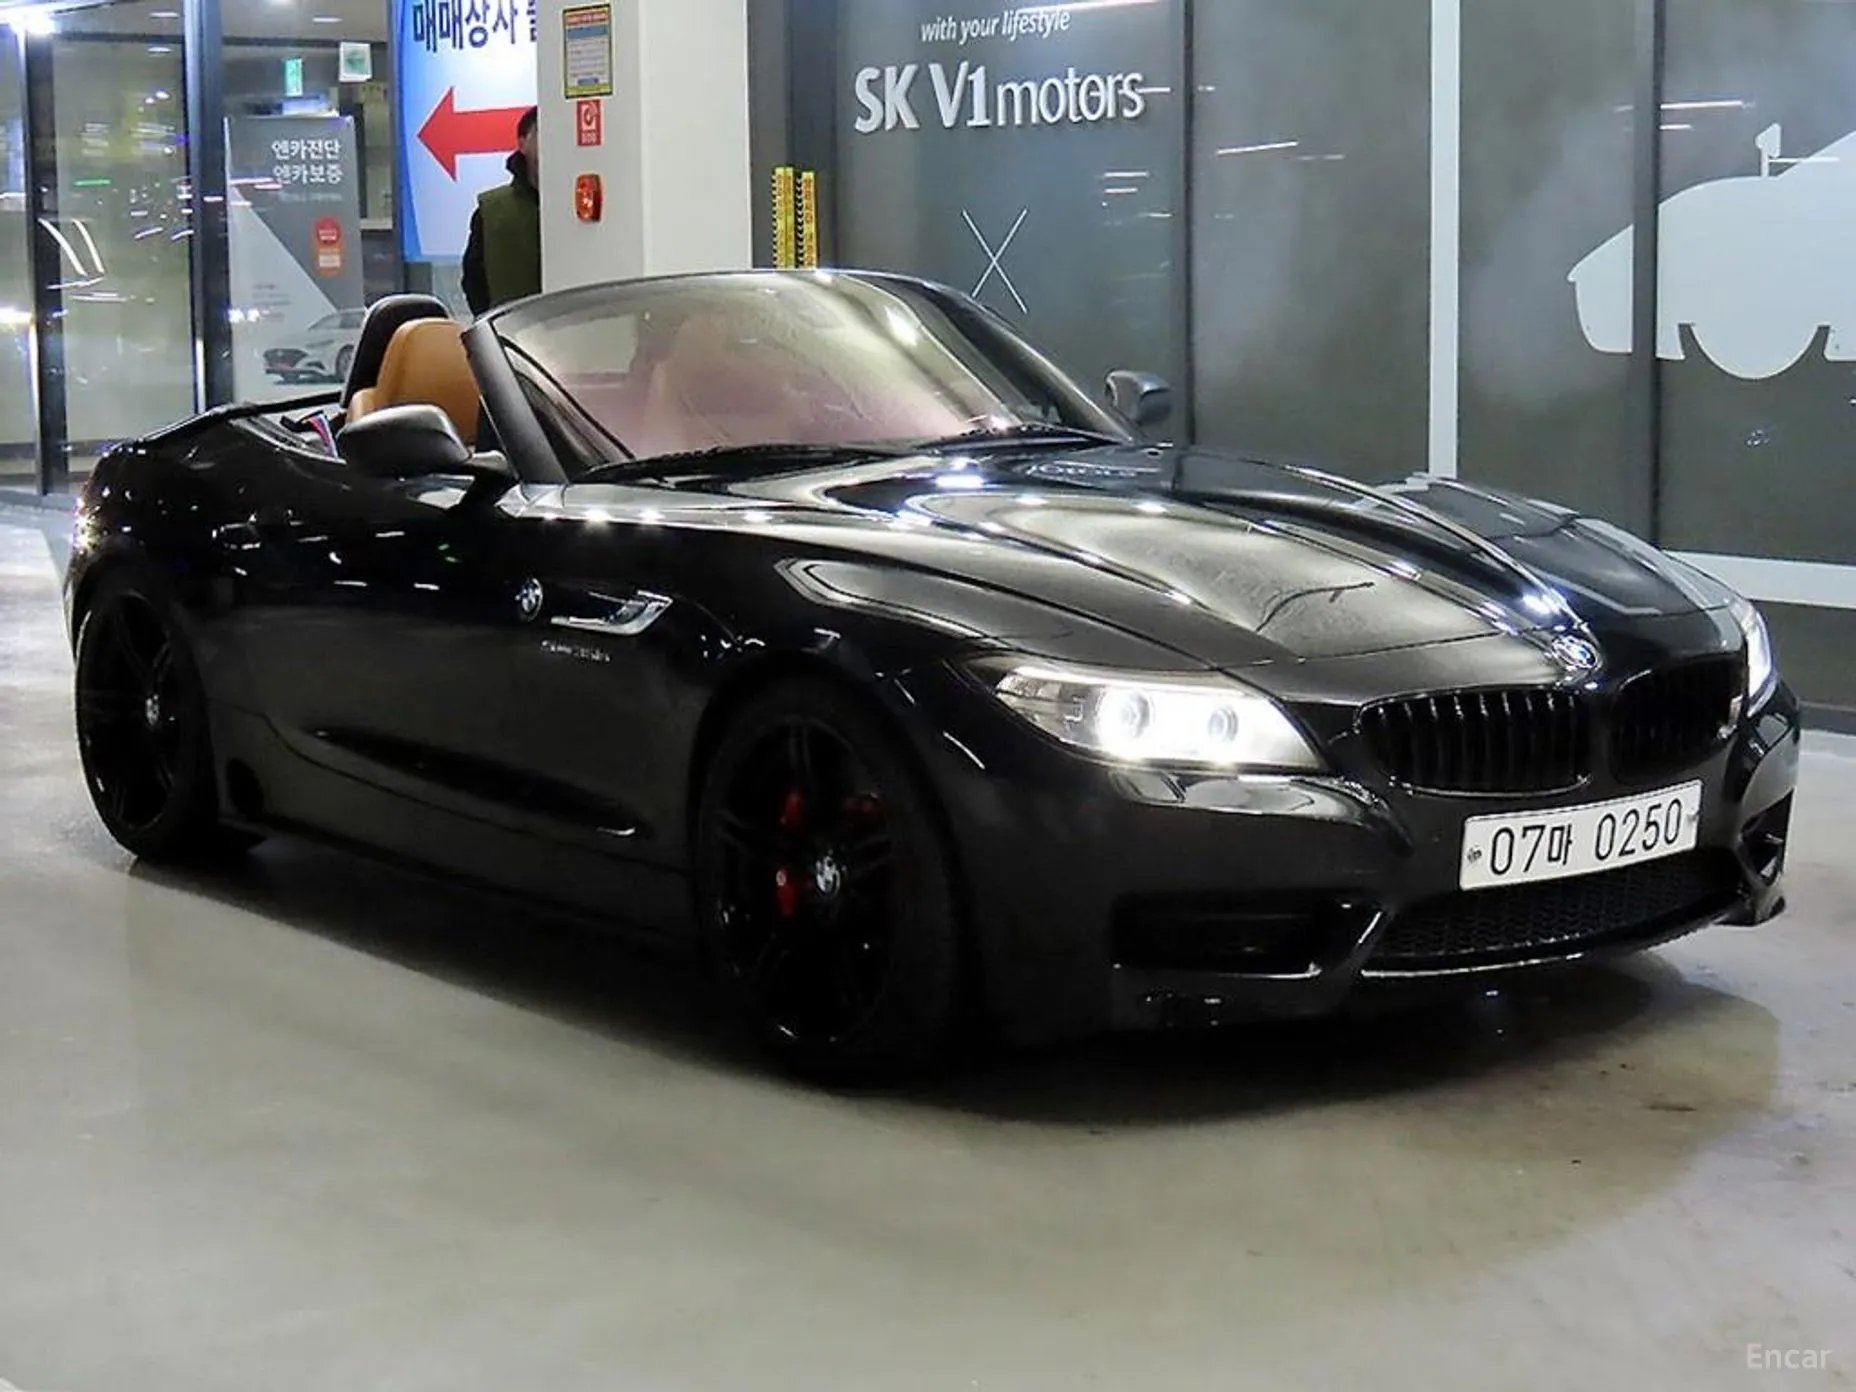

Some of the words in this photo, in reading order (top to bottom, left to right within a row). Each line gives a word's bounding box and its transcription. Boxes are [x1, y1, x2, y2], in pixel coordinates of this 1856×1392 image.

[413, 0, 518, 52] 매매상사
[921, 16, 957, 42] with
[959, 19, 999, 45] your
[1002, 8, 1070, 41] lifestyle
[854, 64, 920, 133] SK
[271, 139, 341, 160] 엔카진단
[1490, 823, 1573, 875] 07마
[1594, 798, 1682, 861] 0250
